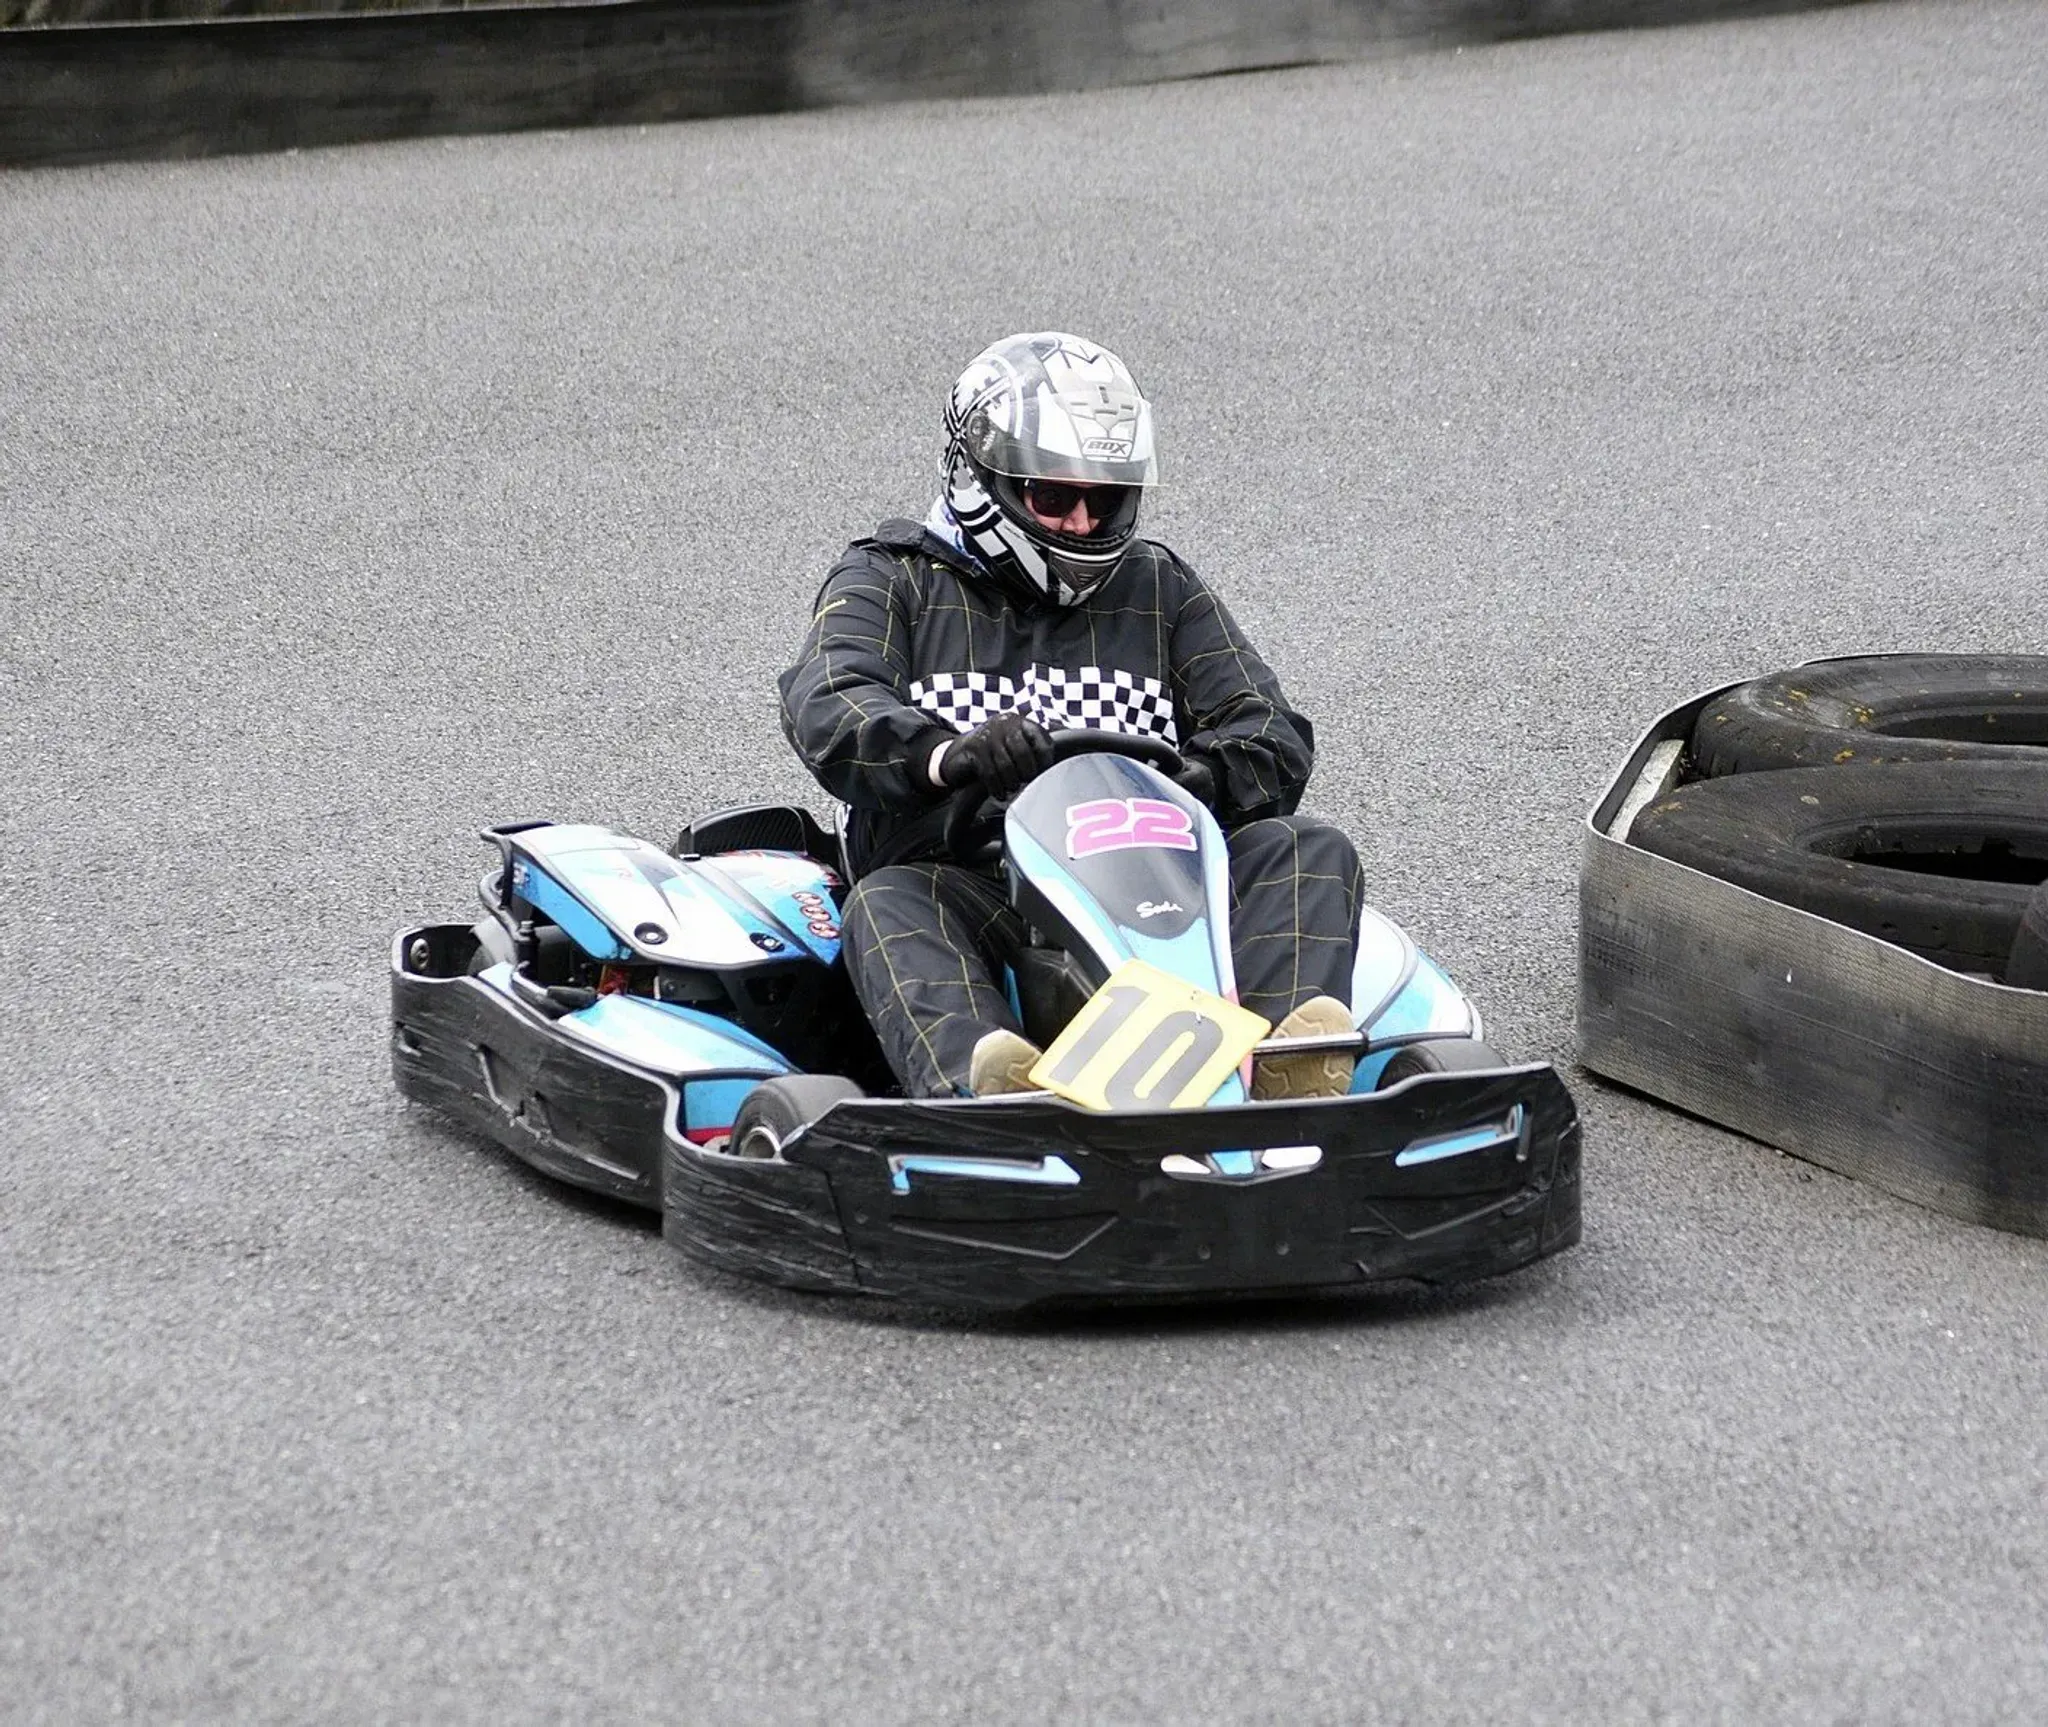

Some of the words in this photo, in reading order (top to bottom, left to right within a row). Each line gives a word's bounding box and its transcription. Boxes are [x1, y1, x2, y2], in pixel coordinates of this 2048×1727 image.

[1087, 441, 1129, 455] BOX
[1065, 797, 1199, 860] 22
[1047, 985, 1224, 1111] 10
